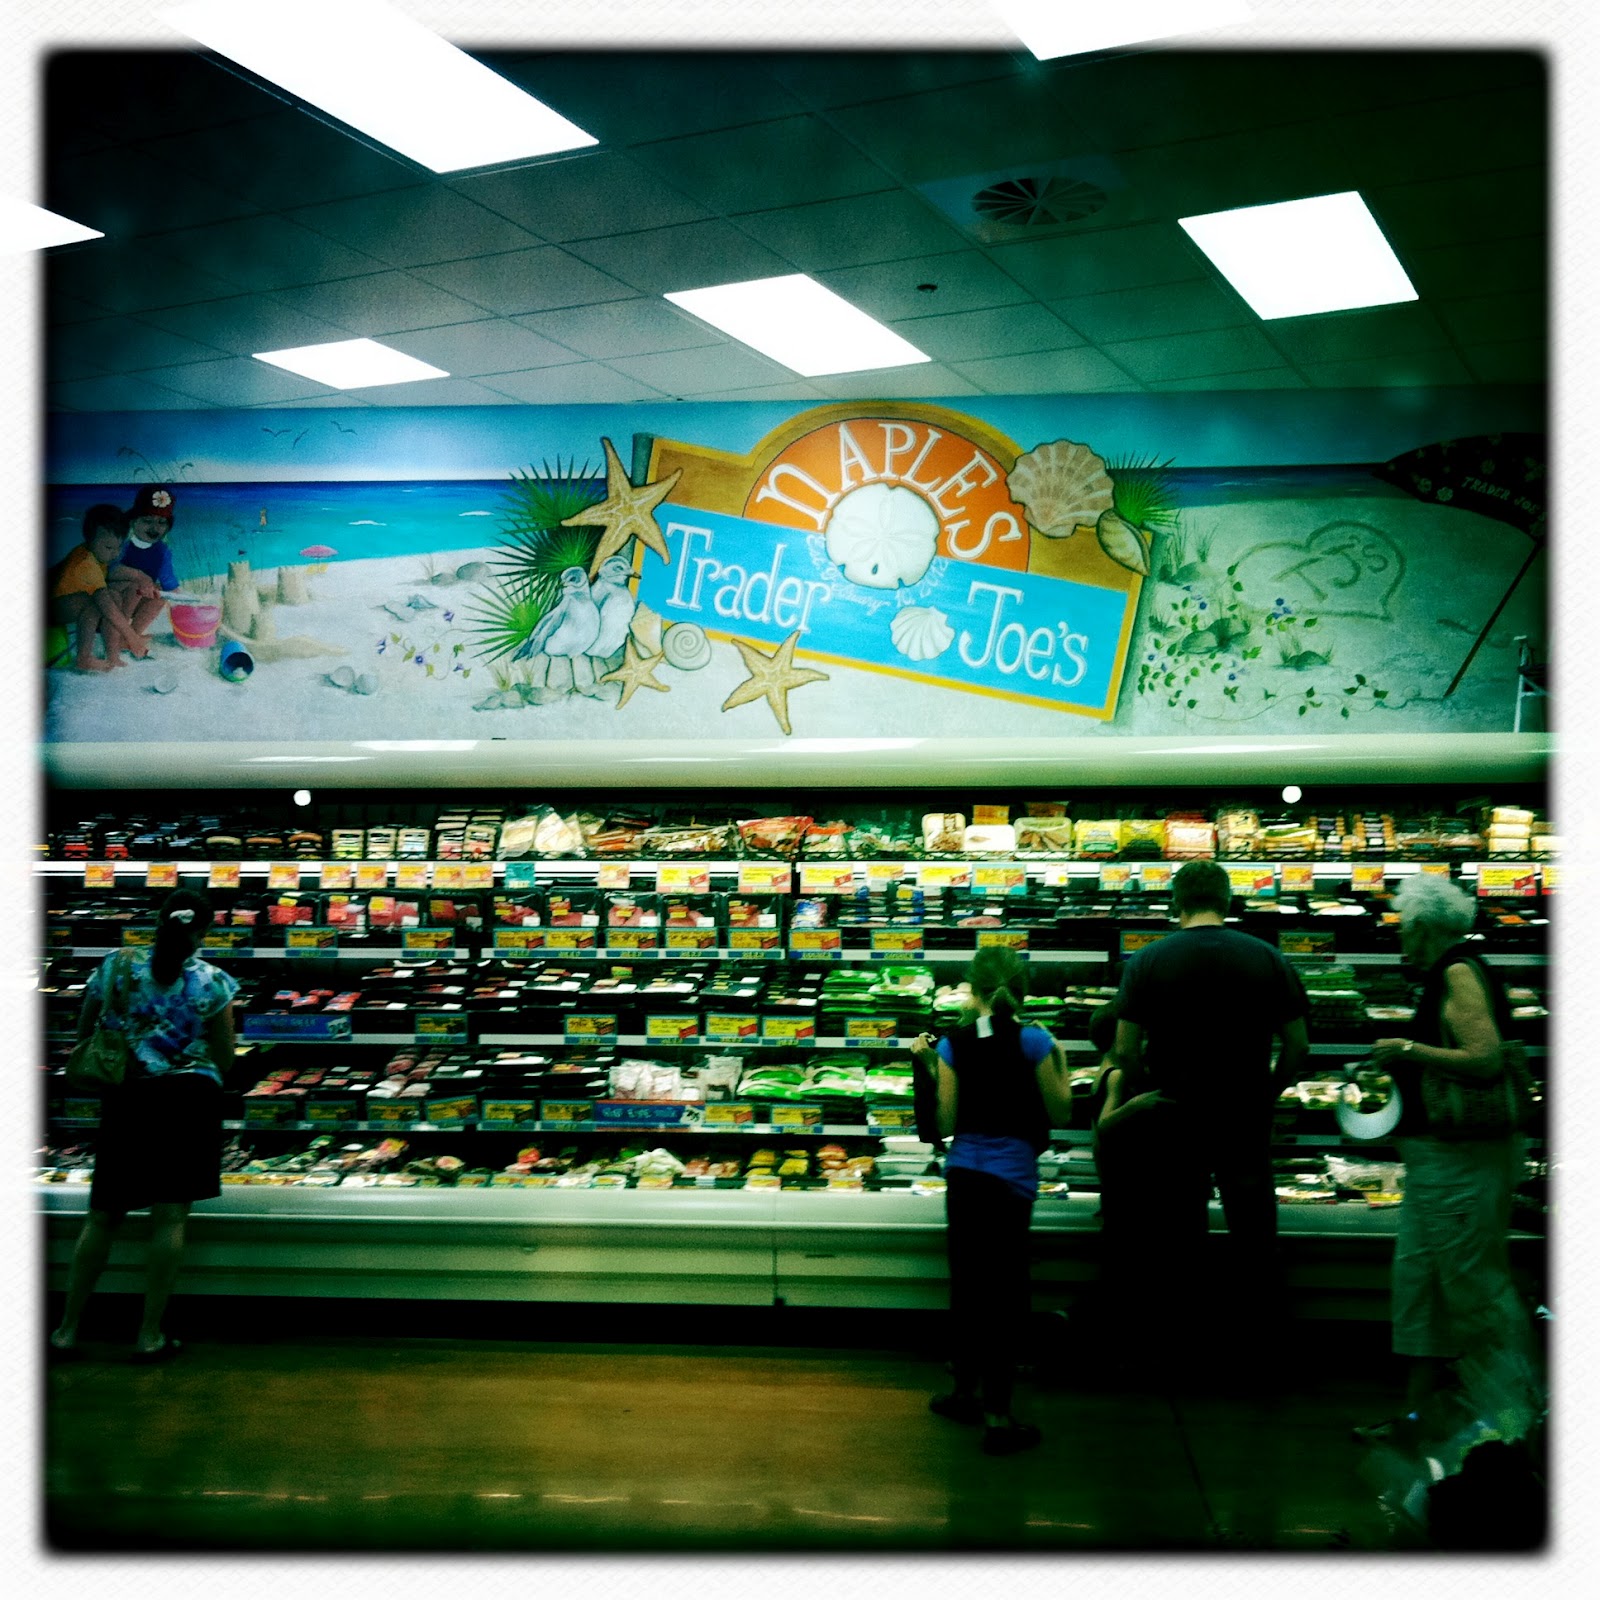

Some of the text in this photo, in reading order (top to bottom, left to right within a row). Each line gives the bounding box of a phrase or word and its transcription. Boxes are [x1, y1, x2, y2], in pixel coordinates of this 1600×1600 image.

[1460, 475, 1511, 501] TRADER
[665, 521, 1089, 687] Trader Joe's
